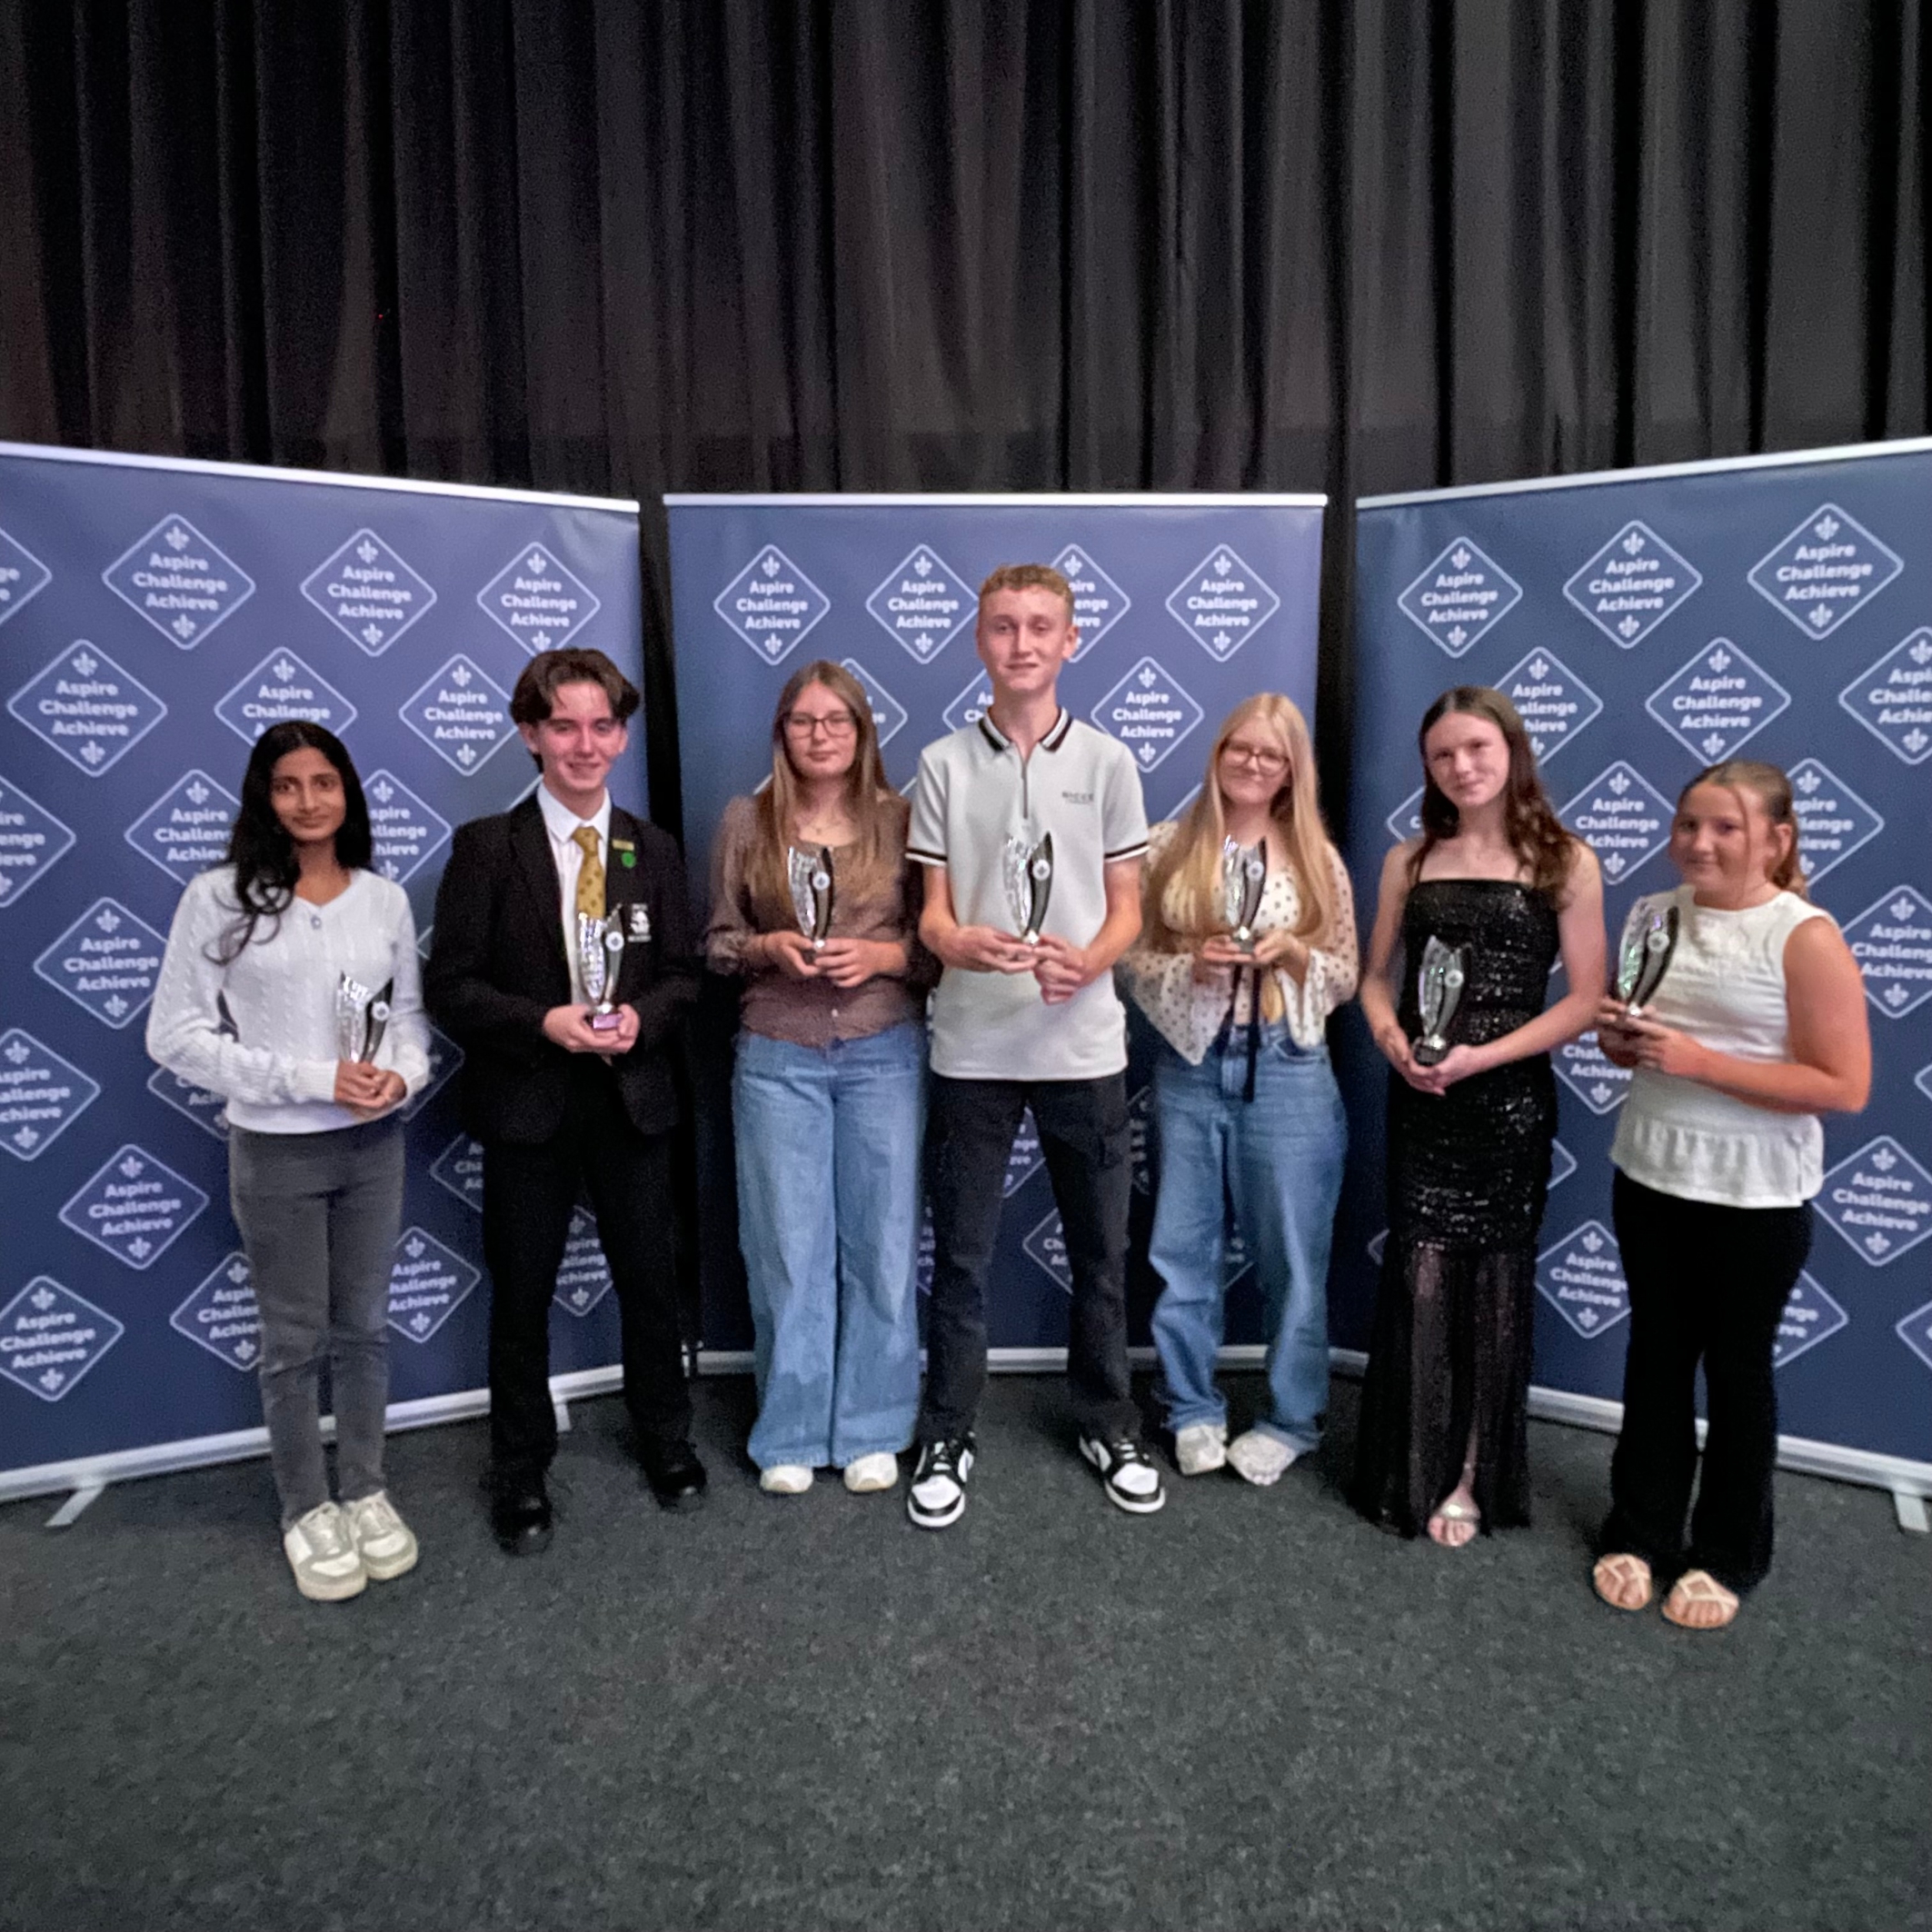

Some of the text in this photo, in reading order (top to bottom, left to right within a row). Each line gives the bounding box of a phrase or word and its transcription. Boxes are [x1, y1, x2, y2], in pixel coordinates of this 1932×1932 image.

[1794, 543, 1856, 562] Aspire
[149, 553, 209, 571] Aspire
[1605, 559, 1659, 575] Aspire
[343, 565, 395, 583] Aspire
[1435, 573, 1484, 589] Aspire
[1777, 563, 1873, 582] Challenge
[133, 572, 228, 593] Challenge
[513, 577, 562, 593] Aspire
[749, 581, 794, 596] Aspire
[901, 580, 946, 595] Aspire
[1200, 580, 1244, 595] Aspire
[1588, 576, 1676, 595] Challenge
[327, 583, 413, 603] Challenge
[1420, 591, 1499, 607] Challenge
[1785, 583, 1860, 602] Achieve
[145, 593, 219, 611] Achieve
[501, 594, 577, 612] Challenge
[736, 598, 809, 614] Challenge
[888, 597, 959, 613] Challenge
[1187, 596, 1258, 612] Challenge
[1597, 595, 1664, 612] Achieve
[338, 603, 403, 620] Achieve
[511, 612, 571, 627] Achieve
[1429, 608, 1489, 623] Achieve
[744, 616, 802, 630] Achieve
[896, 615, 951, 629] Achieve
[1194, 614, 1250, 627] Achieve
[1689, 676, 1746, 692] Aspire
[1887, 666, 1932, 685] Aspi
[55, 681, 119, 698] Aspire
[258, 684, 314, 702] Aspire
[438, 689, 488, 705] Aspire
[1512, 682, 1563, 700] Aspire
[1868, 688, 1932, 705] Challe
[1125, 691, 1170, 706] Aspire
[1672, 694, 1762, 712] Challenge
[39, 700, 139, 719] Challenge
[242, 703, 331, 722] Challenge
[424, 706, 503, 724] Challenge
[1112, 708, 1182, 723] Challenge
[1515, 701, 1578, 717] allenge
[1877, 707, 1932, 724] Achie
[52, 720, 130, 737] Achieve
[1524, 719, 1568, 732] hieve
[1679, 713, 1751, 729] Achieve
[434, 724, 496, 740] Achieve
[1120, 725, 1174, 739] Achieve
[1592, 798, 1645, 814] Aspire
[1792, 796, 1837, 814] spire
[171, 808, 228, 825] Aspire
[371, 806, 411, 822] spire
[372, 824, 426, 840] llenge
[1576, 816, 1660, 833] Challenge
[154, 828, 231, 843] Challen
[166, 846, 227, 861] Achiev
[375, 842, 419, 856] hieve
[1869, 923, 1932, 941] Aspire
[80, 937, 141, 954] Aspire
[1851, 942, 1932, 963] Challeng
[63, 956, 159, 973] Challenge
[76, 974, 151, 991] Achieve
[0, 1068, 51, 1085] spire
[0, 1087, 71, 1103] allenge
[0, 1106, 62, 1123] chieve
[105, 1181, 163, 1199] Aspire
[1852, 1172, 1913, 1191] Aspire
[88, 1199, 182, 1219] Challenge
[1832, 1189, 1931, 1214] Challenge
[101, 1218, 174, 1237] Achieve
[1841, 1210, 1918, 1231] Achieve
[565, 1238, 601, 1252] spire
[392, 1260, 442, 1278] Aspire
[1566, 1252, 1617, 1271] Aspire
[389, 1275, 456, 1295] hallenge
[556, 1270, 607, 1285] chieve
[213, 1286, 255, 1303] Aspi
[388, 1293, 450, 1313] Achieve
[1558, 1286, 1620, 1308] Achieve
[15, 1312, 76, 1331] Aspire
[0, 1328, 96, 1351] Challenge
[12, 1349, 87, 1369] Achieve
